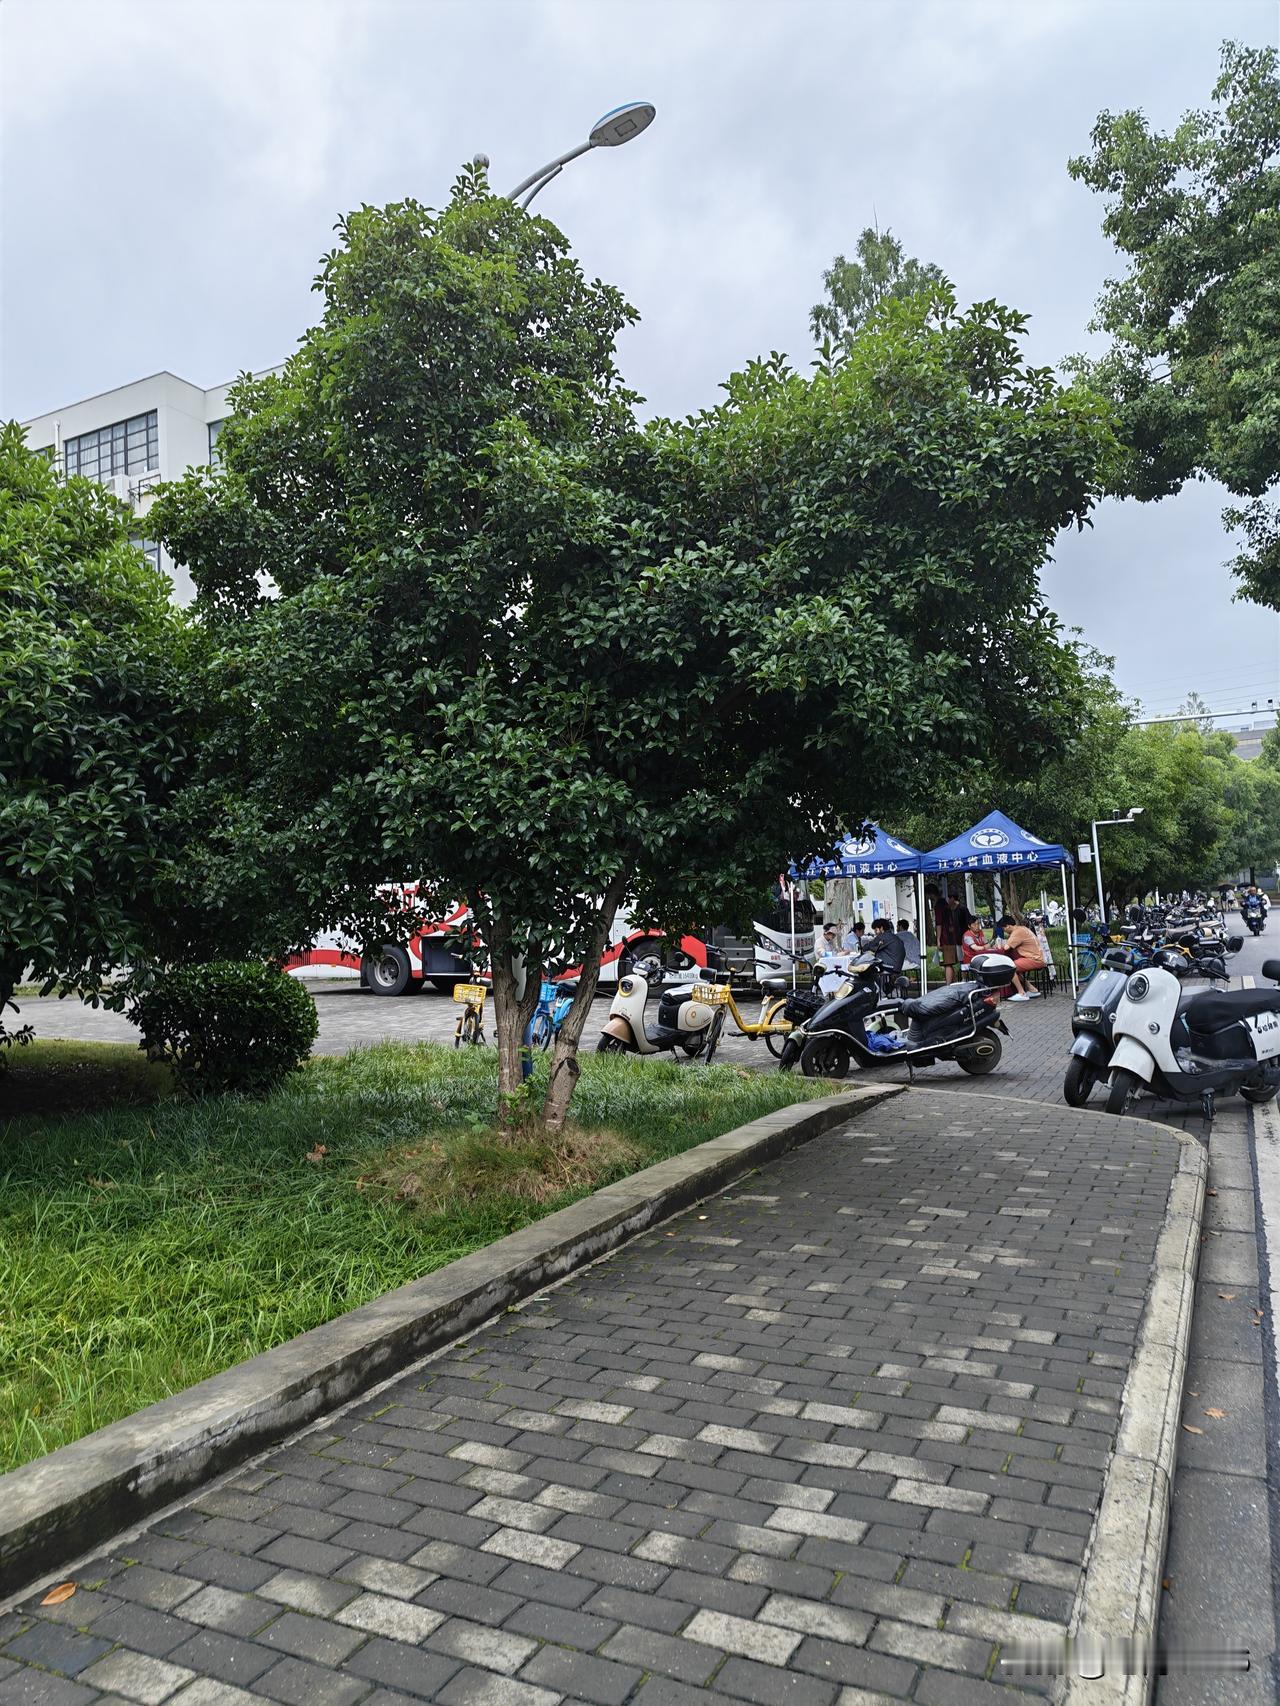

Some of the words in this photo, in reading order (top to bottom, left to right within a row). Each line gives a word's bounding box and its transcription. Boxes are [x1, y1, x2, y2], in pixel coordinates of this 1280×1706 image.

[938, 851, 1039, 870] 江苏省血液中心
